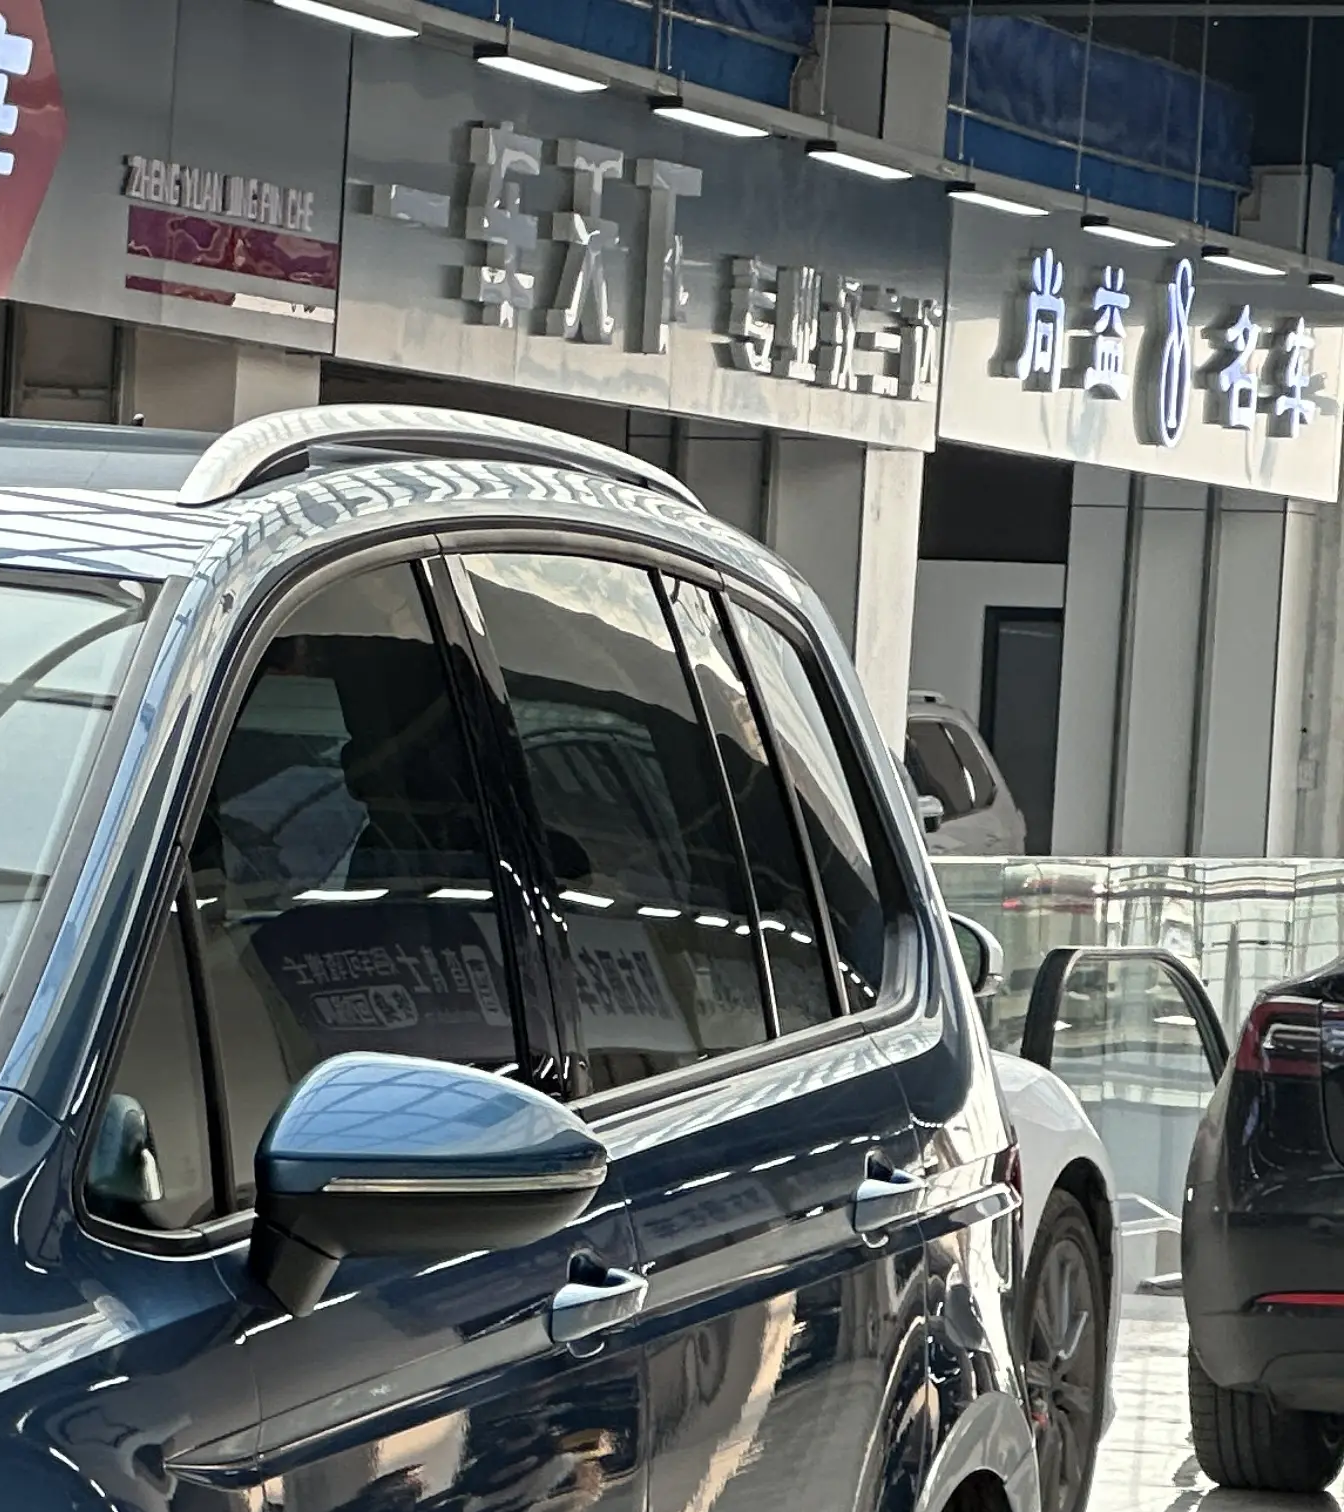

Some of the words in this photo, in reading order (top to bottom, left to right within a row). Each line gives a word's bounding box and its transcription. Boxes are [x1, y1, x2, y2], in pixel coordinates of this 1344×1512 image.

[372, 119, 704, 354] 一车天下
[1218, 304, 1317, 438] 名车
